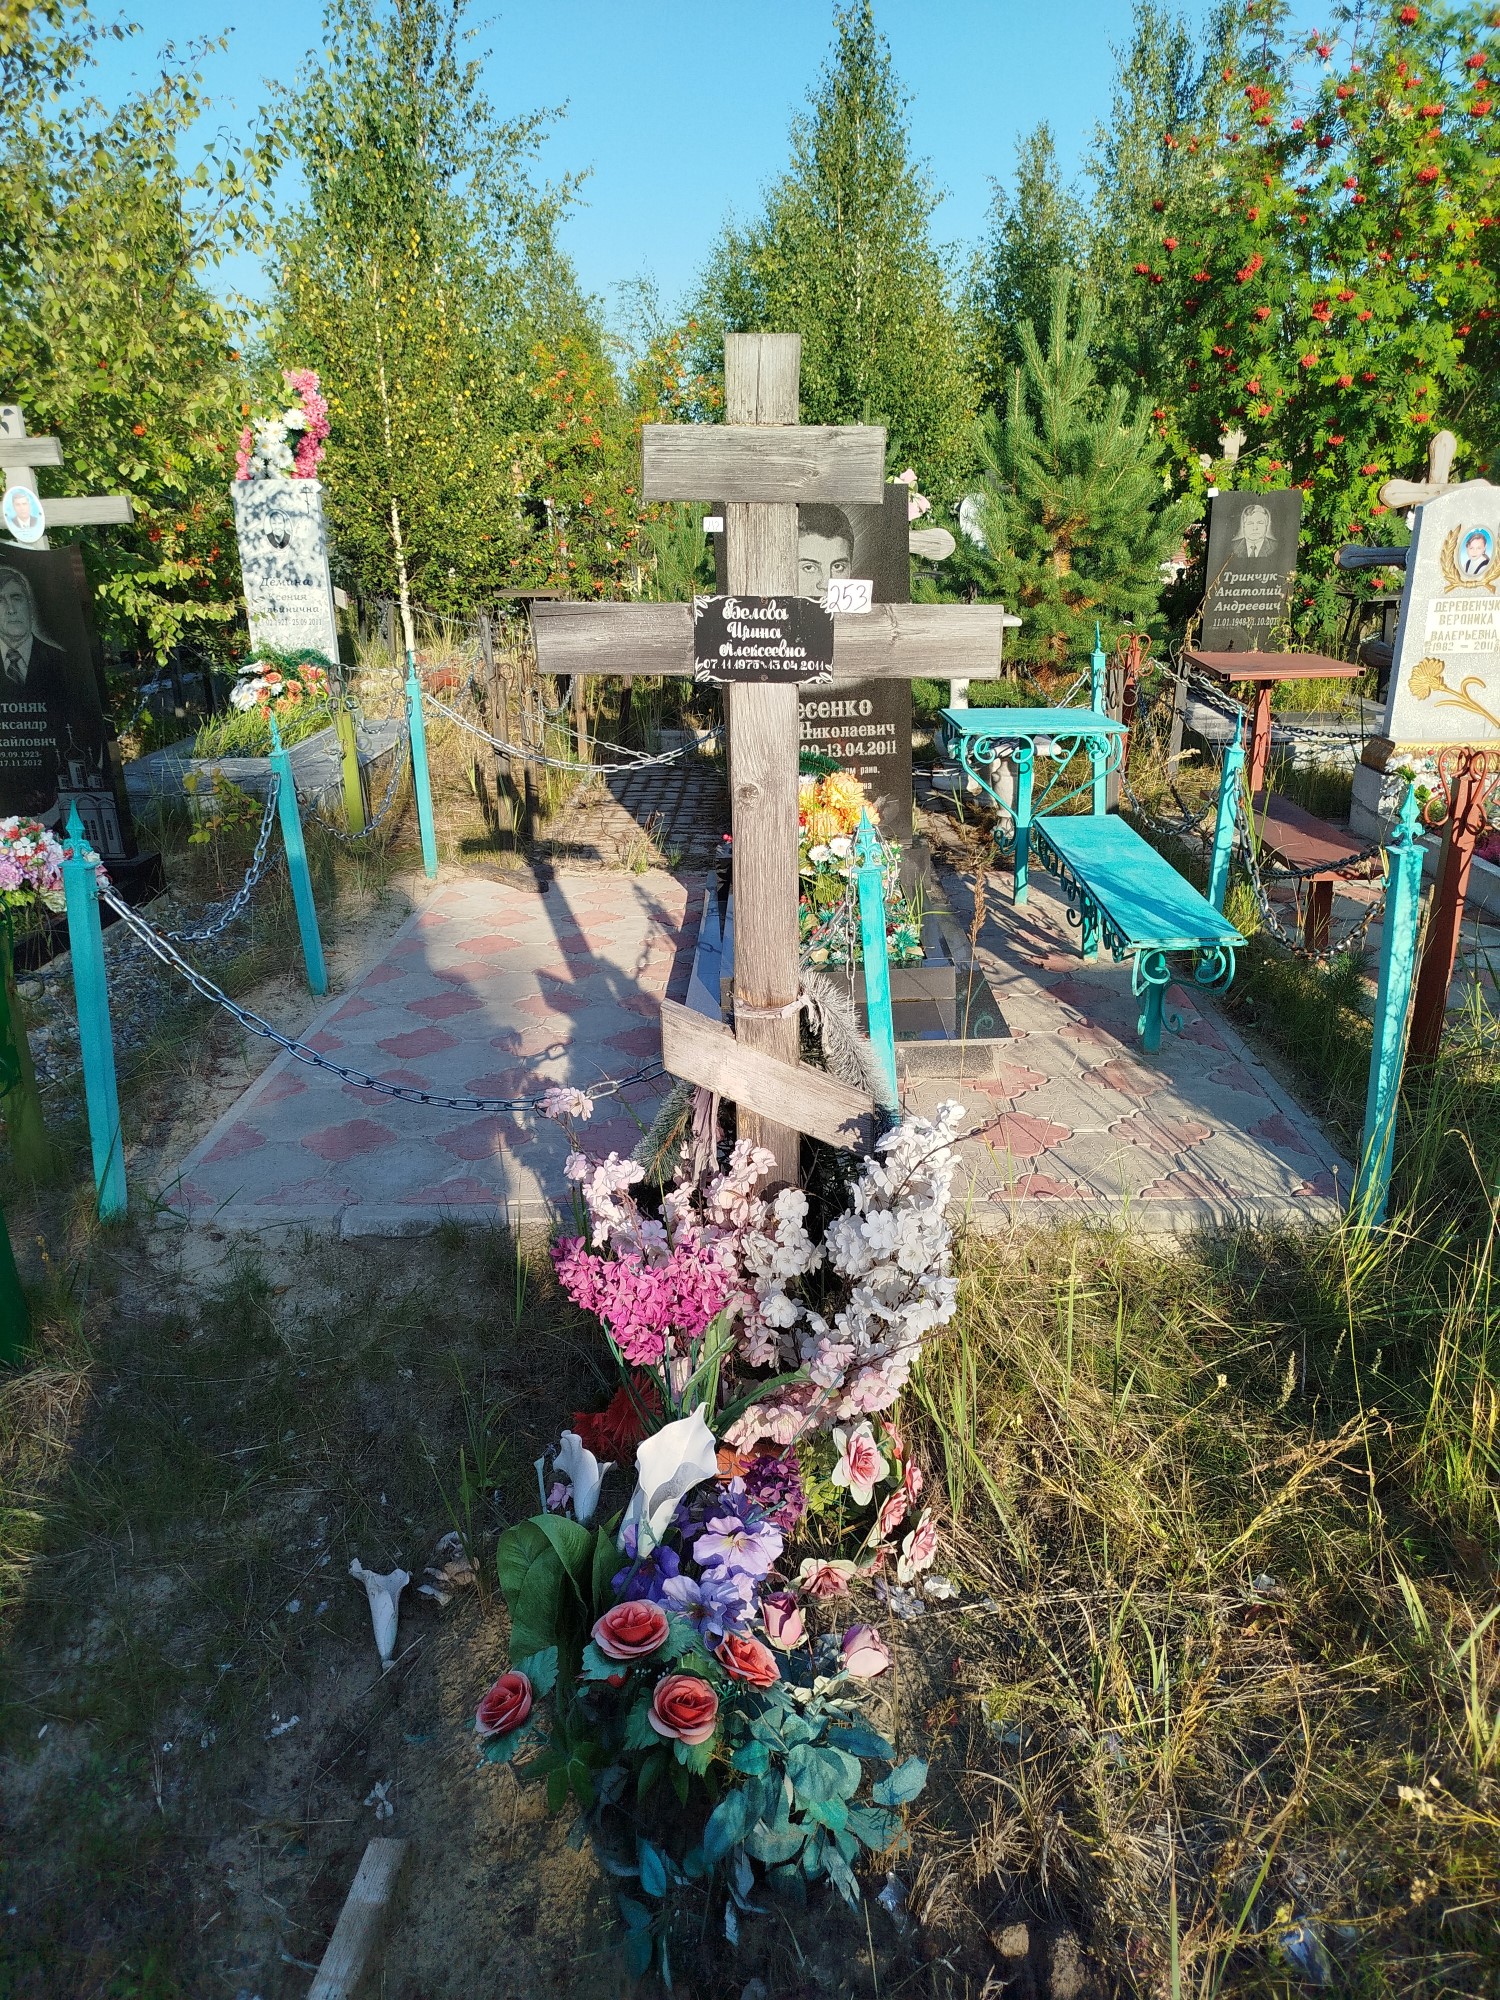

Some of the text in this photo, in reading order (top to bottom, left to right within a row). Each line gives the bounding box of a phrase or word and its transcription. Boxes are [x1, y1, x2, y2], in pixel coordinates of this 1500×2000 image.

[1223, 572, 1278, 584] Тринчук
[1215, 584, 1282, 597] Анатолий
[829, 583, 868, 612] 253
[722, 597, 789, 620] Белова
[1213, 600, 1281, 613] Андреевич
[1434, 600, 1500, 613] ДЕРЕВЕНЧУК
[1439, 613, 1493, 626] ВЕРОНИКА
[726, 622, 782, 641] Ирина
[1431, 629, 1497, 642] ВАЛЕРЬЕВНА
[719, 639, 807, 657] Алексеевна
[1474, 640, 1493, 651] 2011
[0, 720, 47, 732] ксандр
[799, 721, 895, 740] Николаевич
